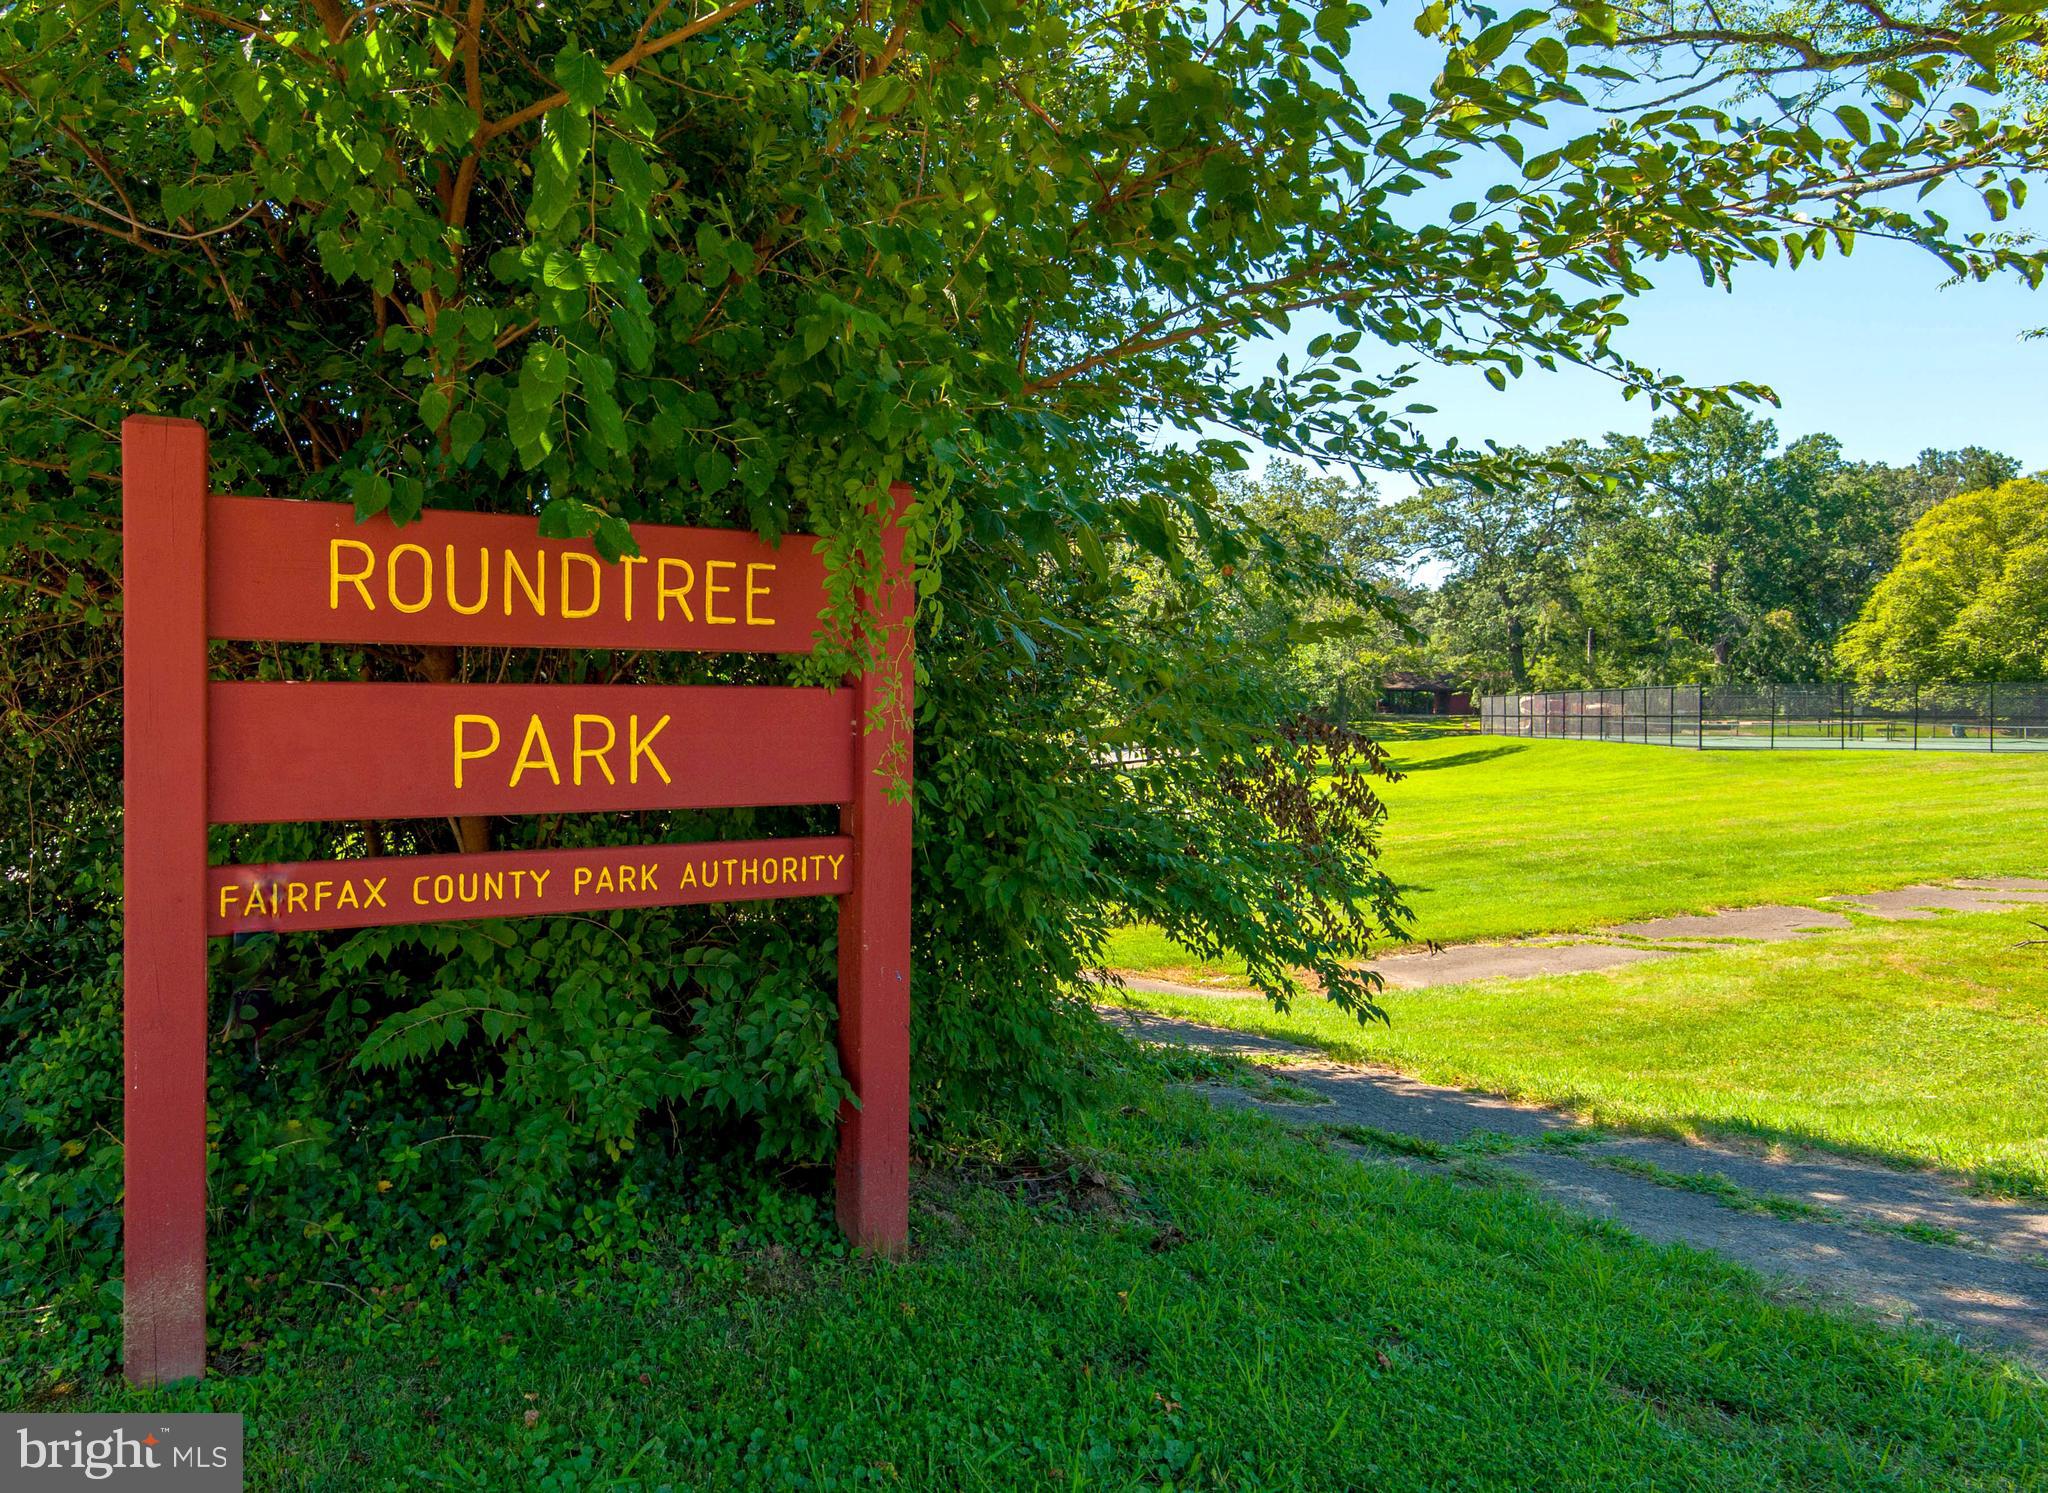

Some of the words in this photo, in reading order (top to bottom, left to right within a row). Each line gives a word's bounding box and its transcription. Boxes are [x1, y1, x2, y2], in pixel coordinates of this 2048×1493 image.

[329, 539, 776, 625] ROUNDTREE
[453, 714, 672, 789] PARK
[220, 878, 387, 917] FAIRFAX
[413, 869, 551, 905] COUNTY
[574, 863, 658, 896] PARK
[680, 854, 844, 889] AUTHORITY
